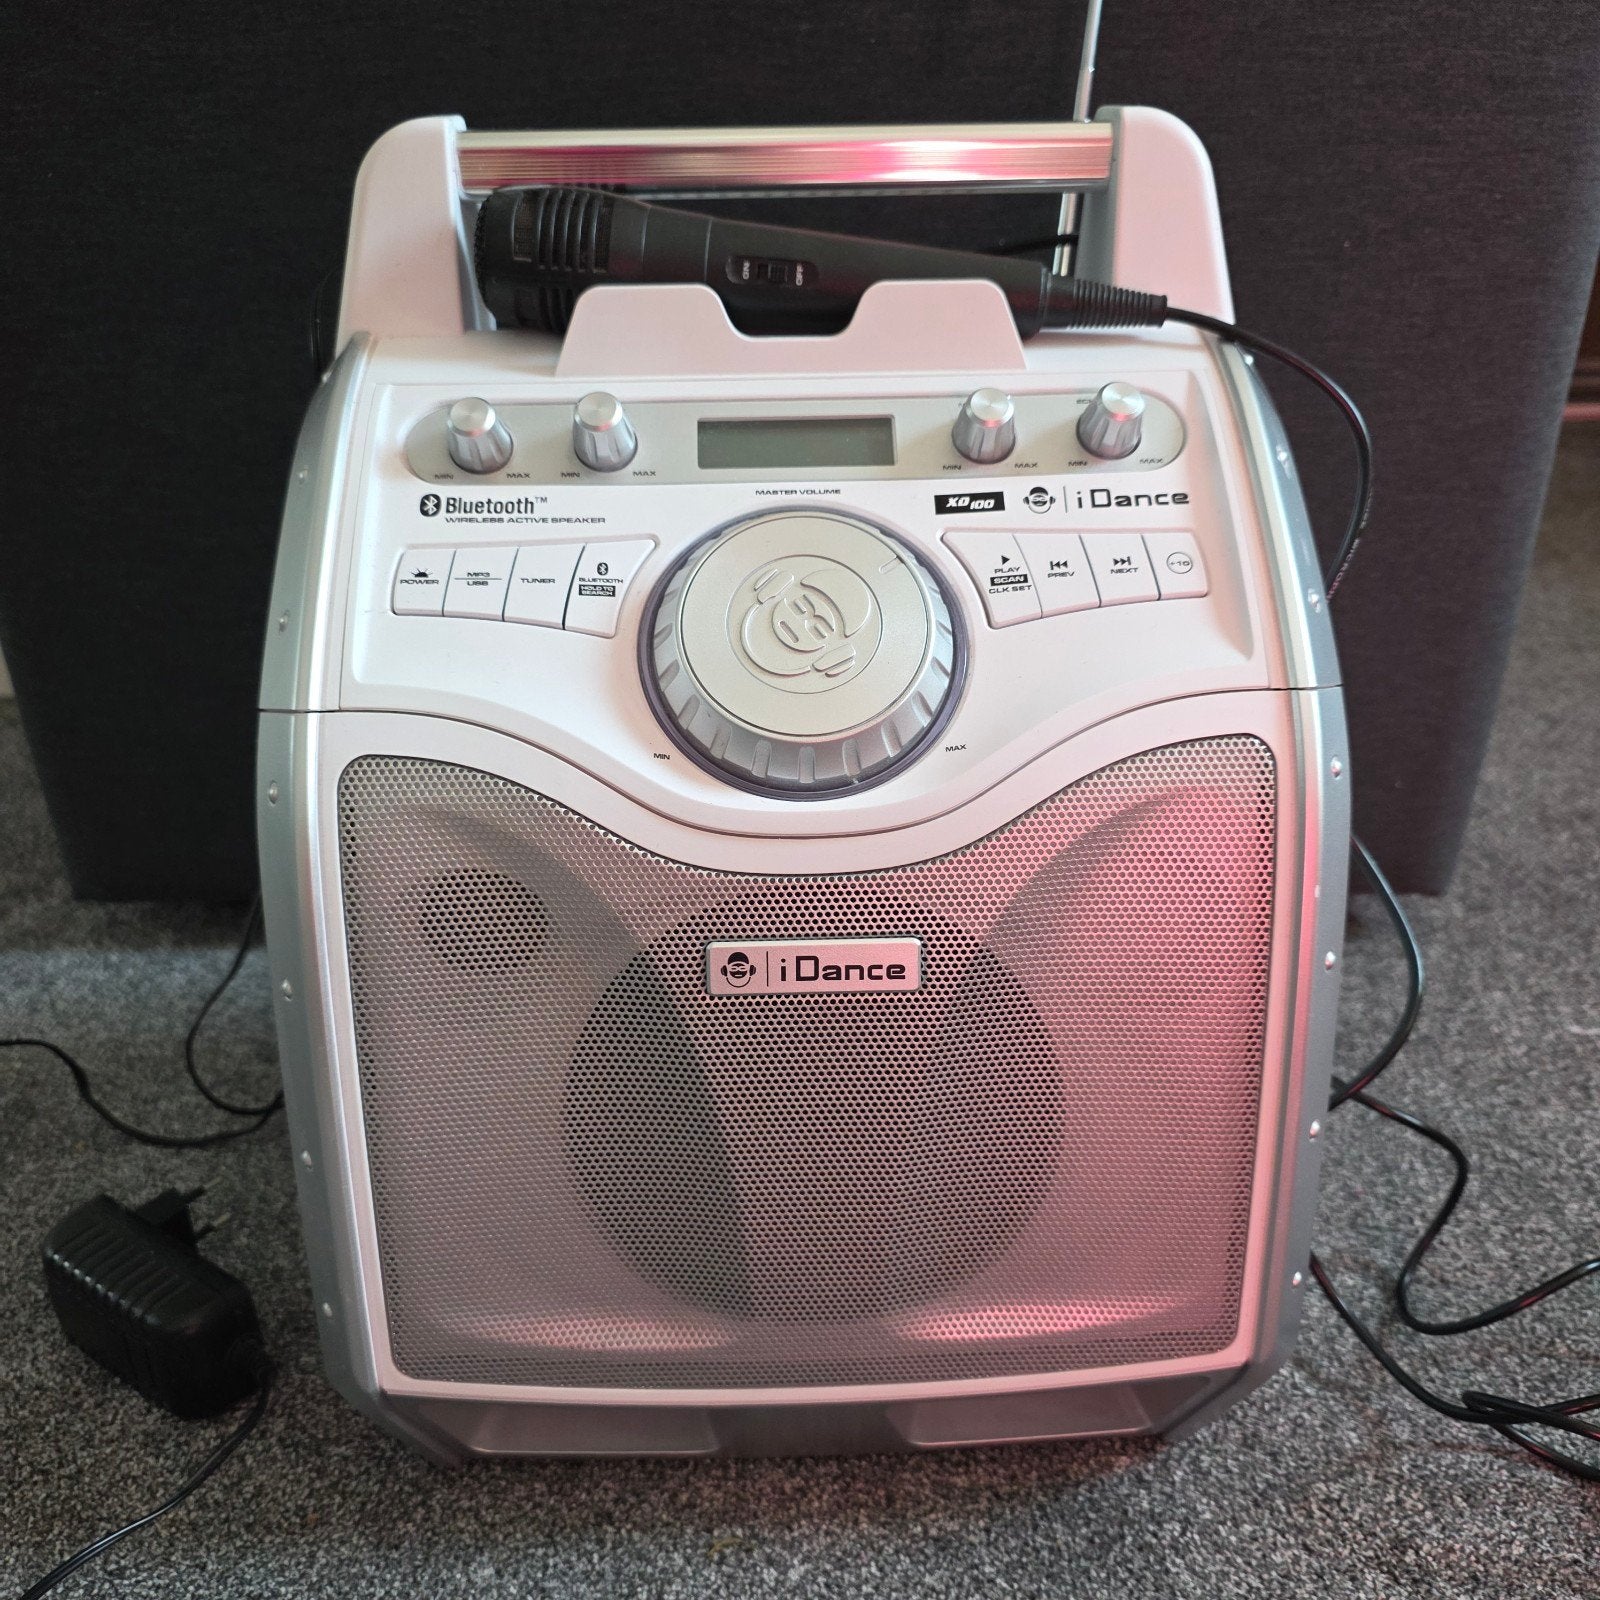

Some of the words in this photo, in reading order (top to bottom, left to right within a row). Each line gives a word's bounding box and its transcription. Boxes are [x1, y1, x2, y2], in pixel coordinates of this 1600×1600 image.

[1014, 461, 1038, 469] MAX
[1067, 459, 1088, 467] MIN
[1139, 457, 1164, 465] MAX
[994, 566, 1021, 574] PLAY
[993, 575, 1025, 584] SCAN
[988, 586, 1010, 594] CLK
[945, 743, 967, 752] MAX
[653, 751, 671, 760] MIN
